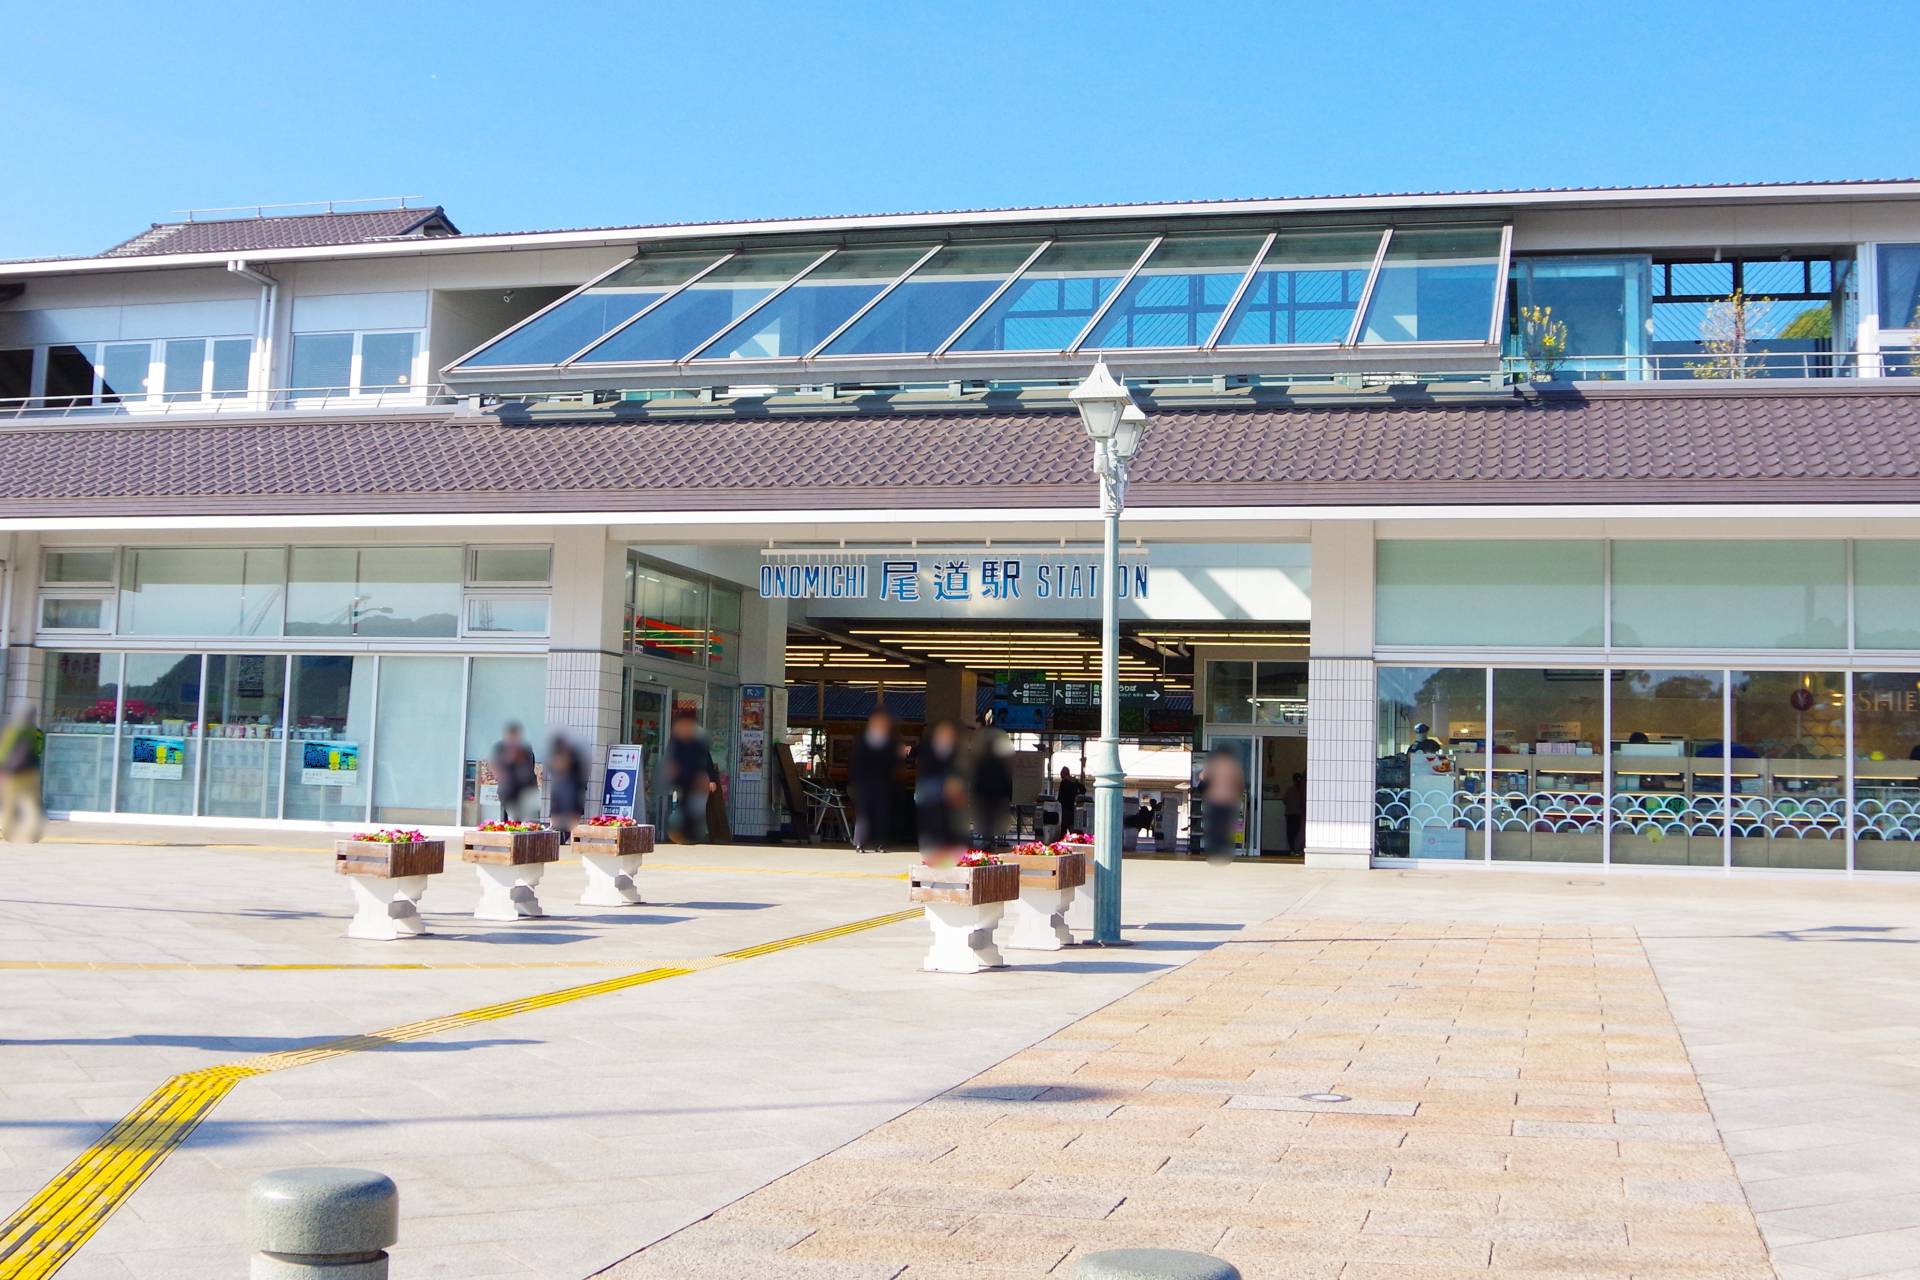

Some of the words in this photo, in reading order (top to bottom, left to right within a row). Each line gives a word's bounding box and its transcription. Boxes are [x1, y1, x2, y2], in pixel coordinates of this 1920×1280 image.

[760, 565, 868, 599] ONOMICHI
[880, 560, 1022, 601] 尾道駅
[1037, 564, 1149, 599] STATON
